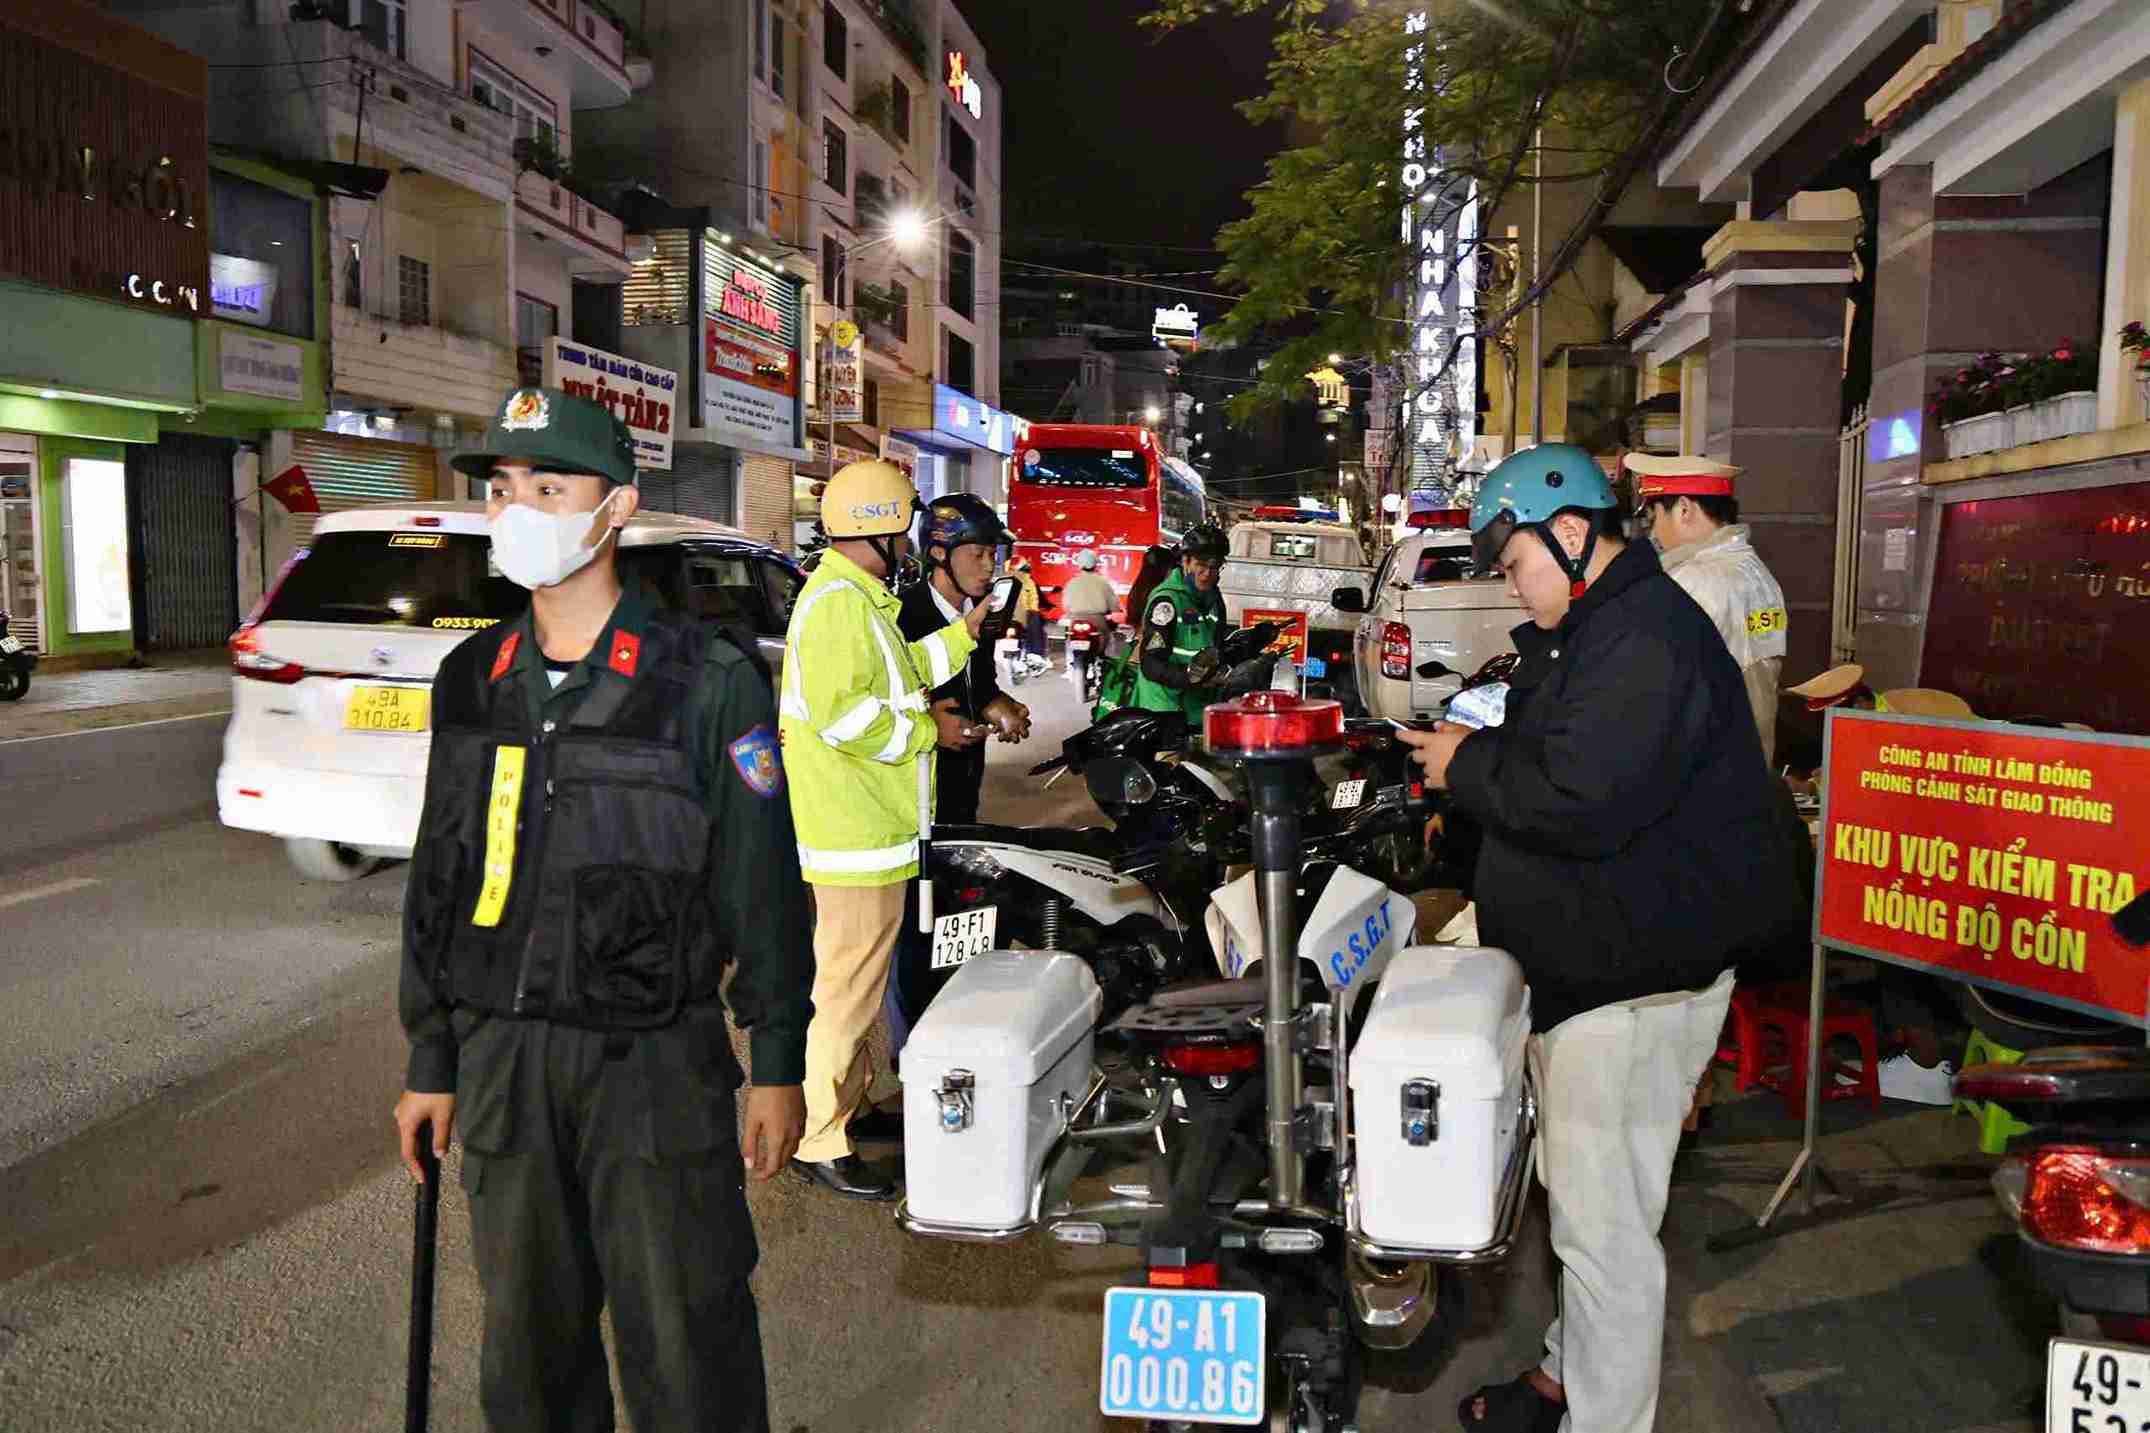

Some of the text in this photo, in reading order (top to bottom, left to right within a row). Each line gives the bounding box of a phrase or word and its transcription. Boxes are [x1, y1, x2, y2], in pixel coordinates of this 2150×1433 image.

[1420, 228, 1445, 318] NHA
[848, 502, 902, 520] CSGT
[1879, 744, 2092, 790] CÔNG AN TỈNH LÂM ĐỒNG
[1860, 770, 2113, 824] PHÒNG CẢNH SÁT GIAO THÔNG
[489, 772, 514, 900] POLIE
[1834, 823, 2137, 914] KHU VỰC KIỂM TRA
[936, 935, 990, 966] 128.48
[943, 912, 985, 939] 49-F1
[1331, 899, 1393, 987] C.S.G.T
[1863, 879, 2087, 973] NỒNG ĐỘ CỒN
[1128, 1297, 1237, 1353] 49-A1
[1110, 1353, 1257, 1413] 000.86
[2073, 1350, 2150, 1405] 49-
